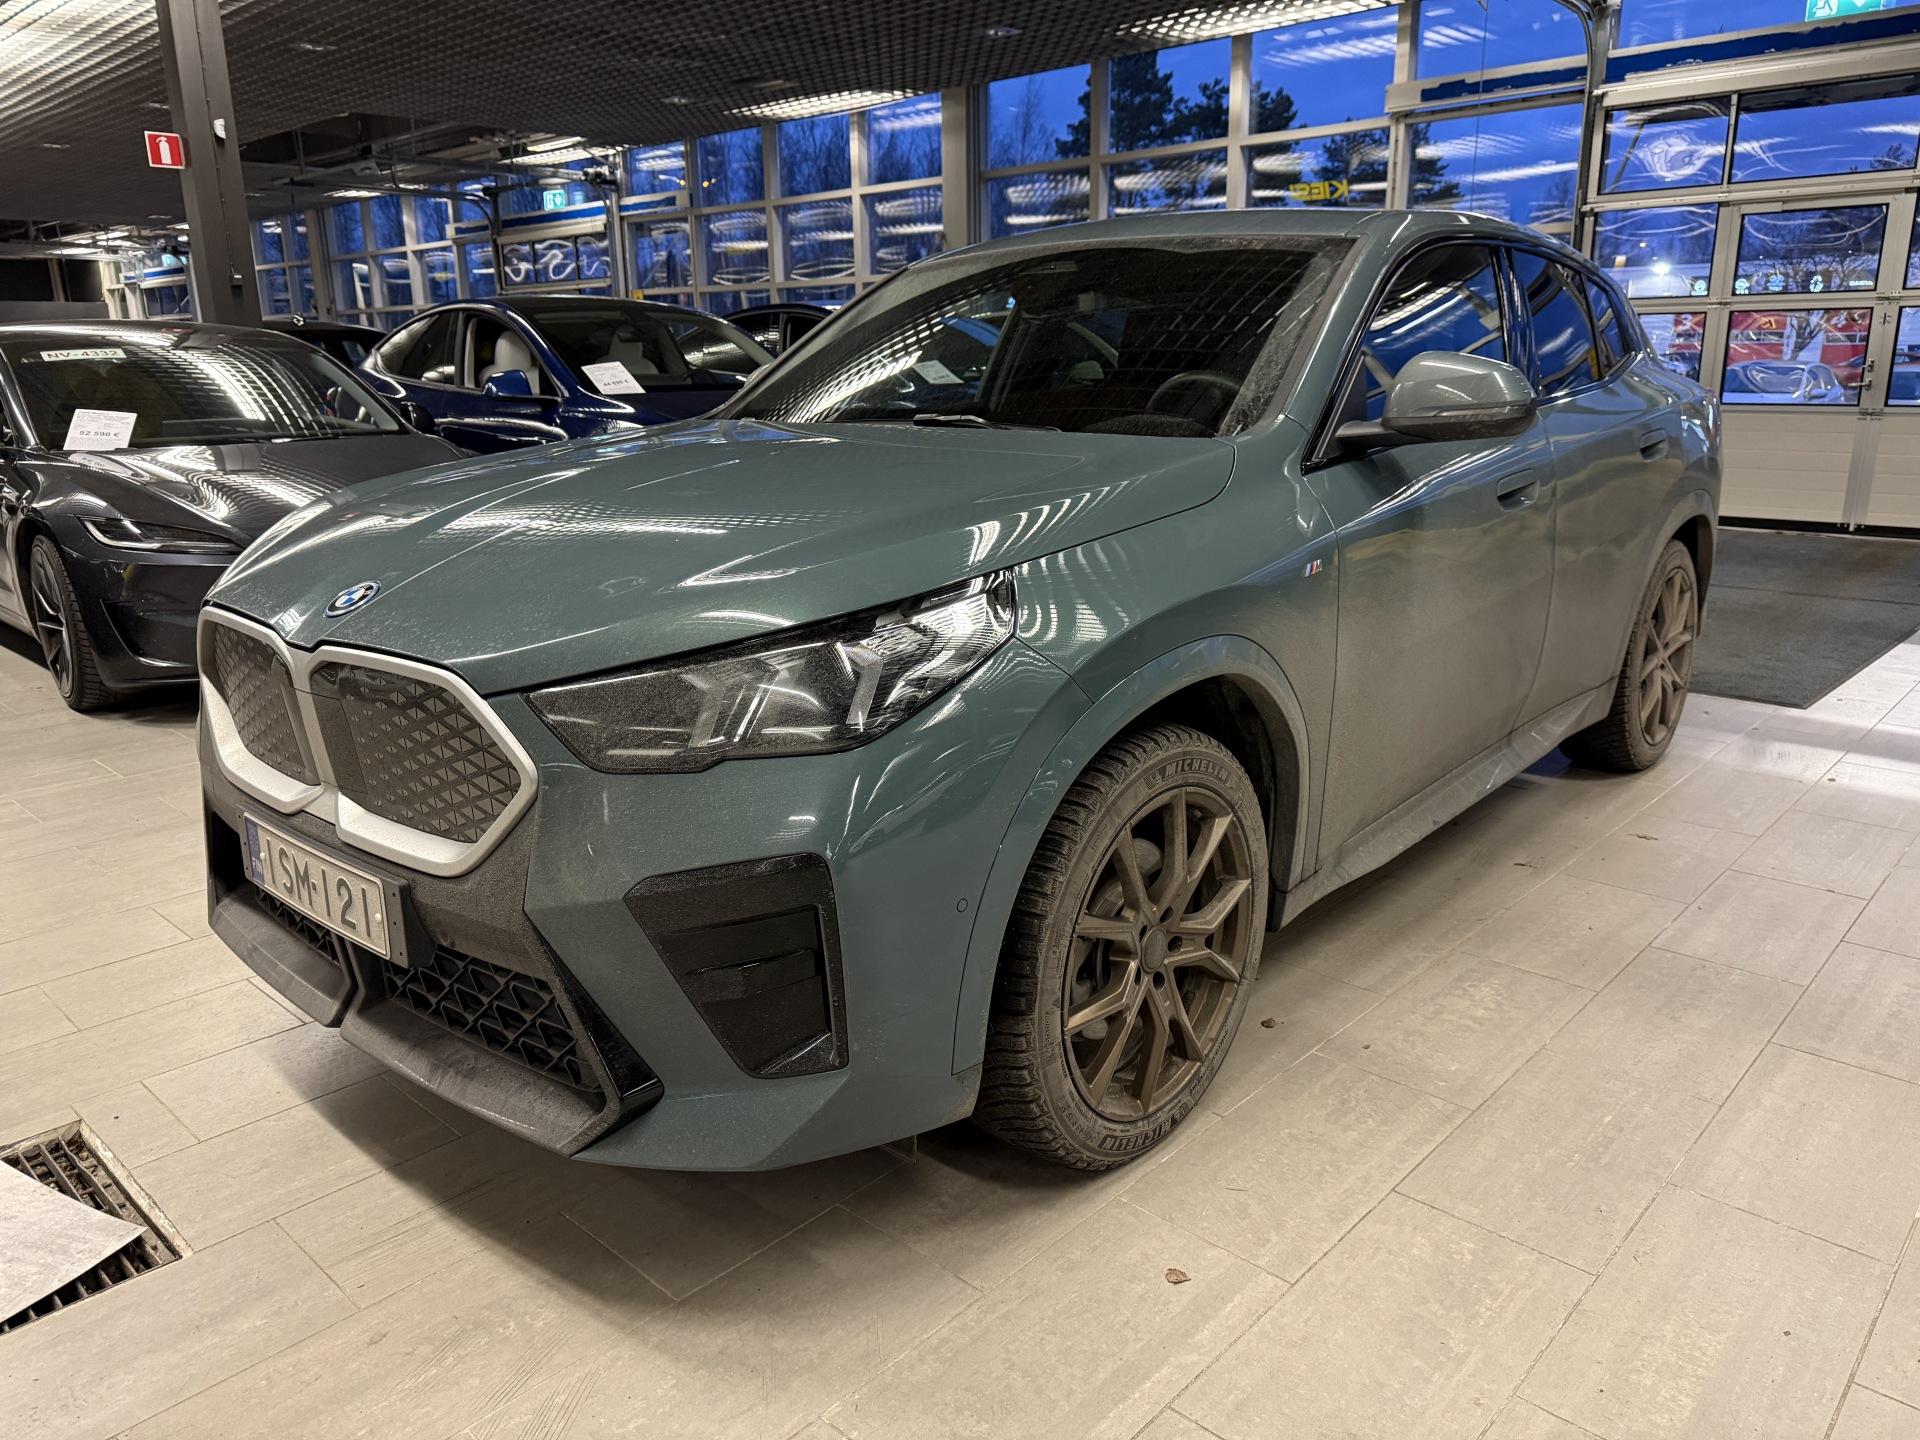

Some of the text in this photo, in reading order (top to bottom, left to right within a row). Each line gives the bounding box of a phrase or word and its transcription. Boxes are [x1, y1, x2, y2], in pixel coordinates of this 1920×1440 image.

[1165, 759, 1230, 781] MICHELIN
[252, 858, 263, 875] FIN
[266, 837, 372, 938] ISM-121
[1102, 1117, 1173, 1150] MICHELIN
